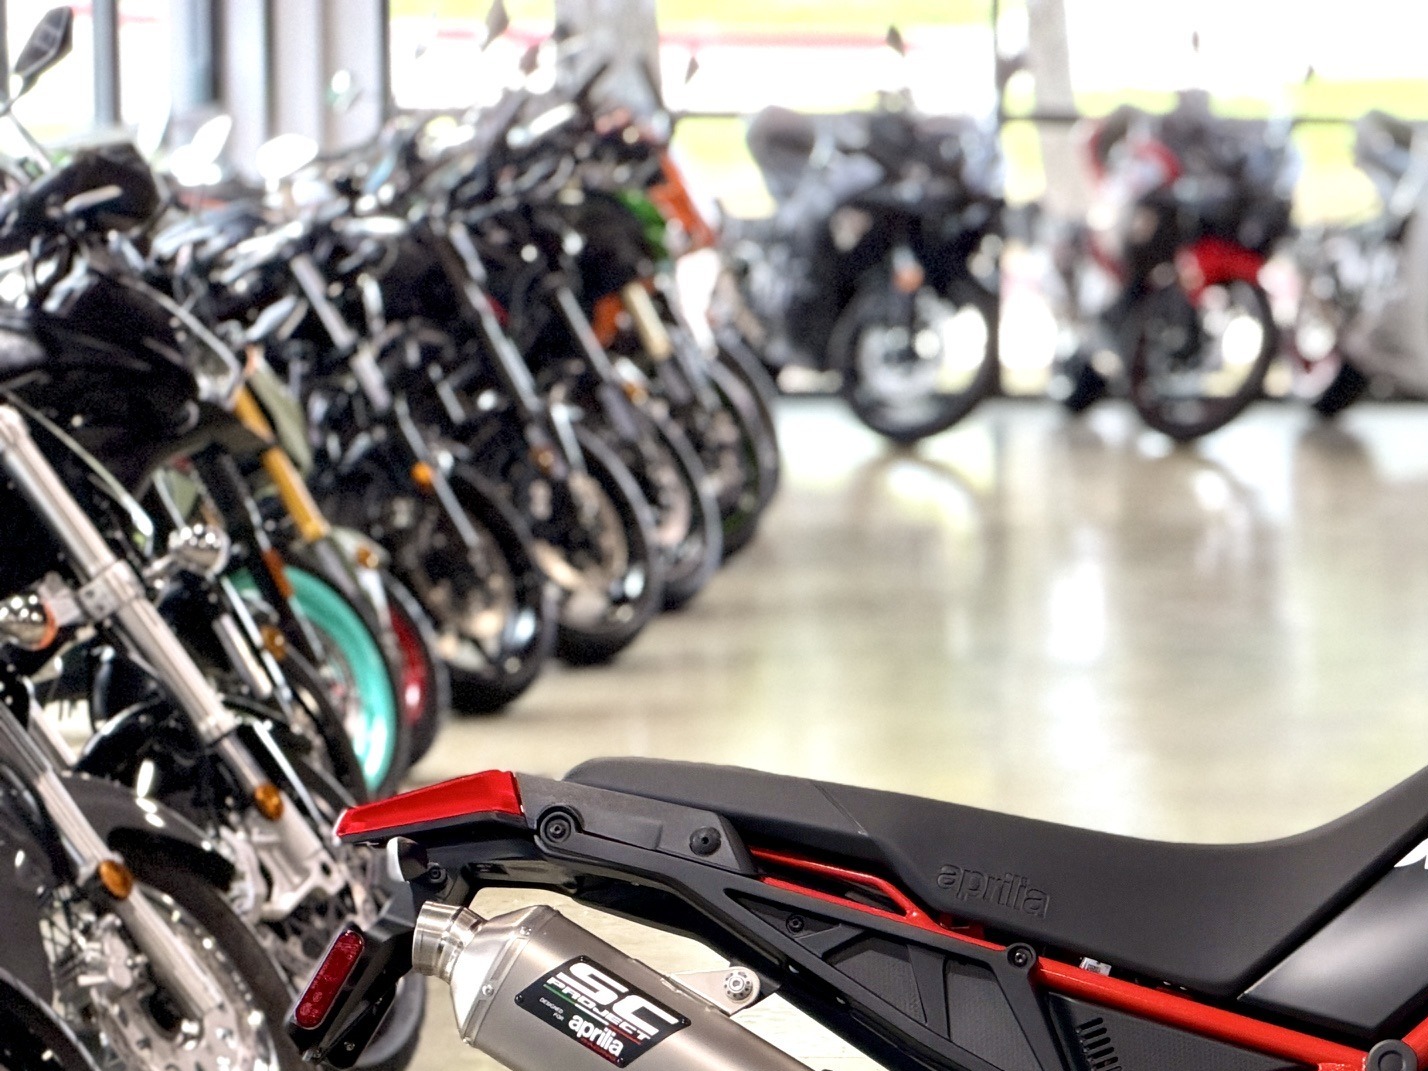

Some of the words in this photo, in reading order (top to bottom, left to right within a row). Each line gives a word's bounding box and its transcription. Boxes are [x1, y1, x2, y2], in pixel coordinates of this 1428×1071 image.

[937, 863, 1050, 918] aprilia
[539, 997, 564, 1014] DESIGNED
[546, 976, 651, 1041] PROJECT
[552, 1012, 565, 1022] FOR
[556, 962, 680, 1036] SC
[568, 1014, 624, 1057] aprilia
